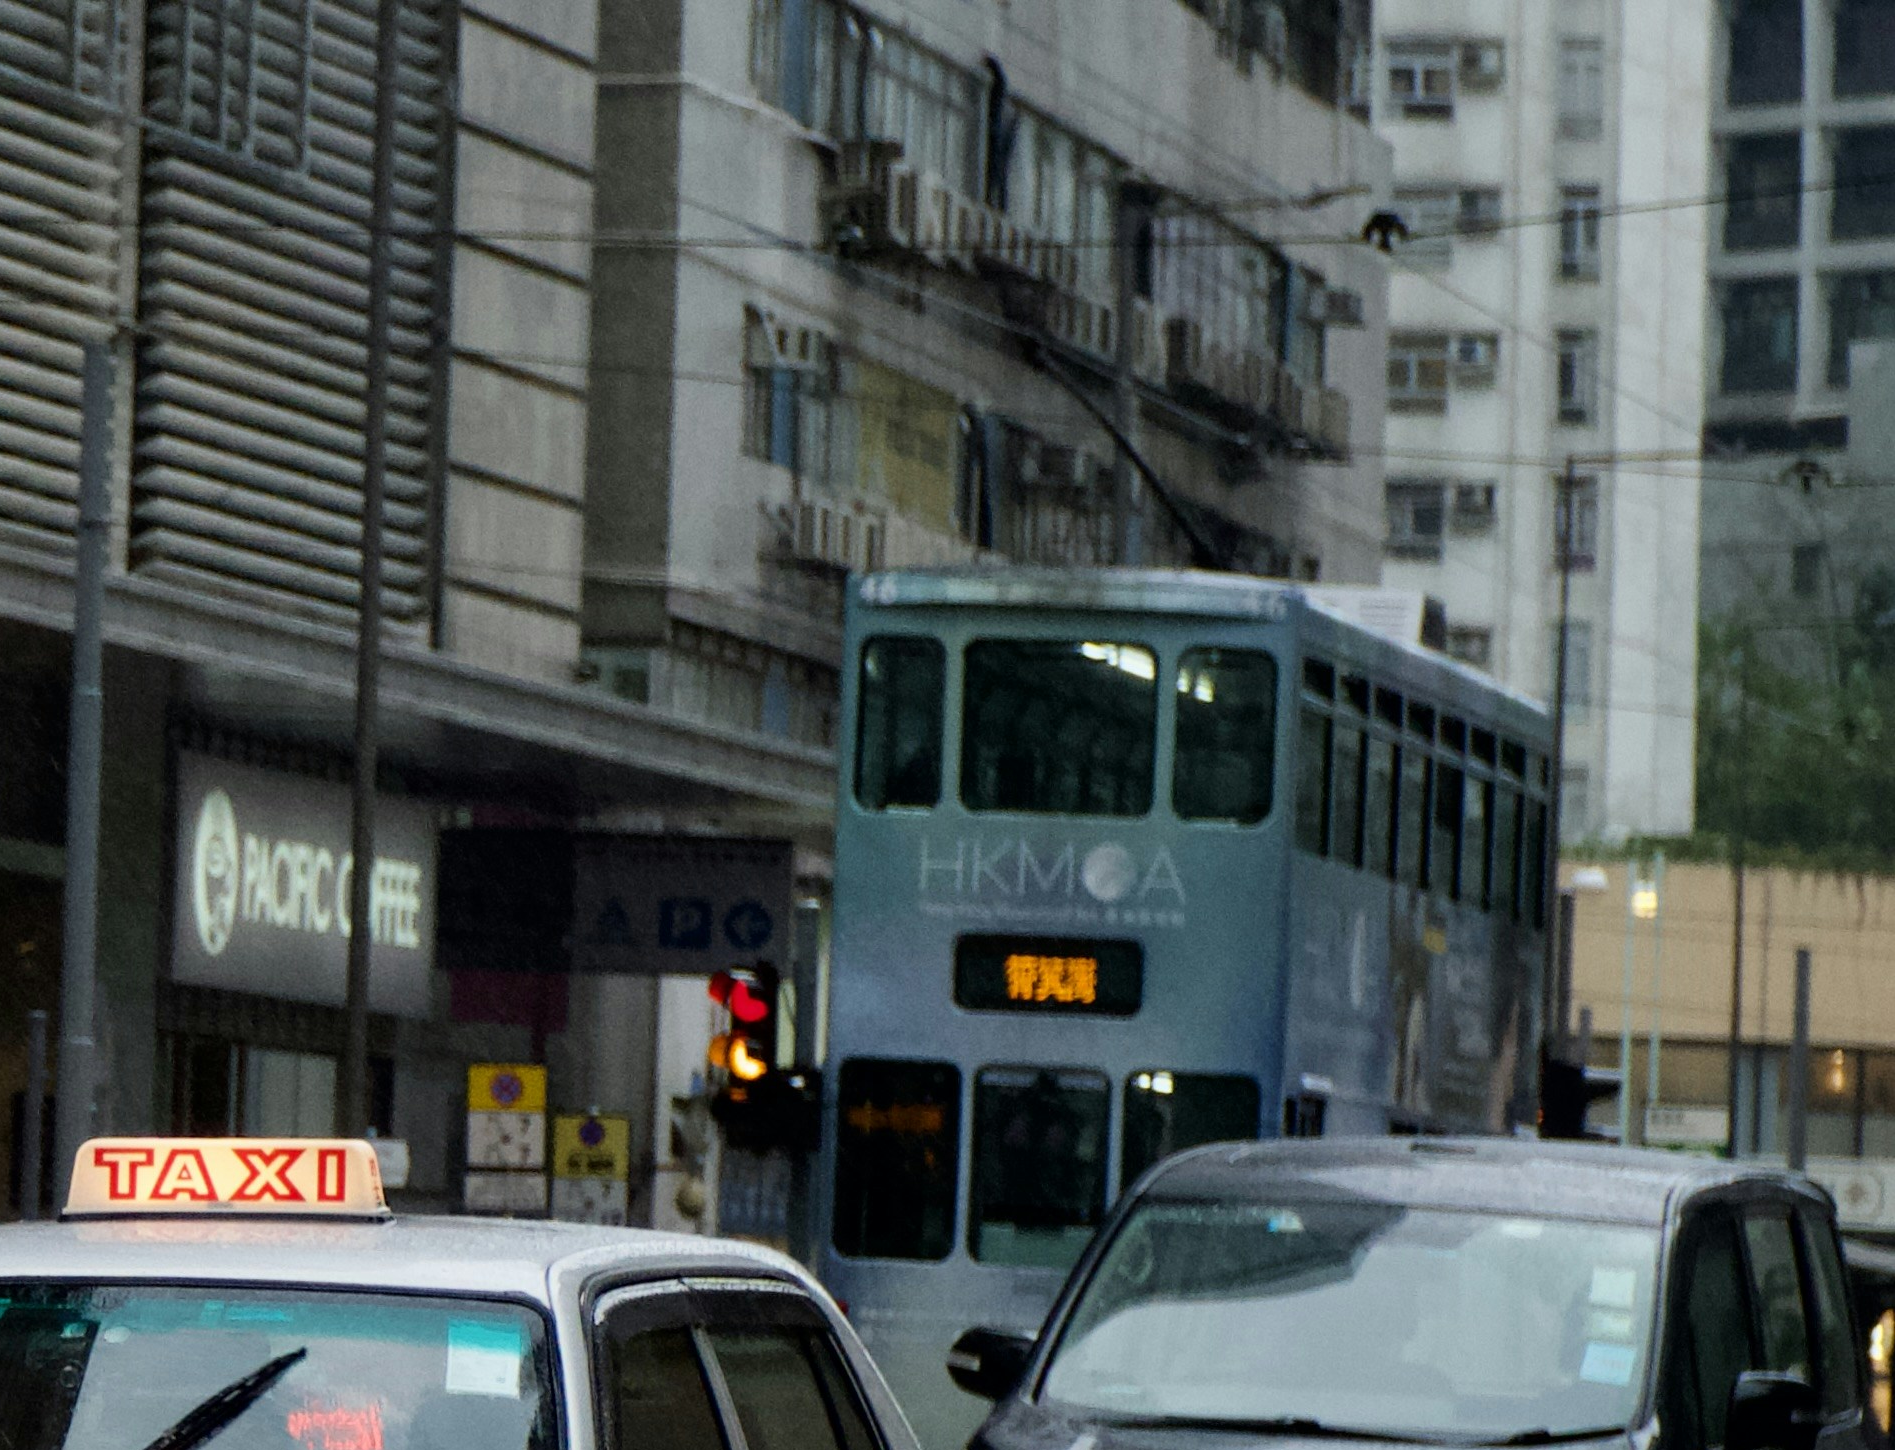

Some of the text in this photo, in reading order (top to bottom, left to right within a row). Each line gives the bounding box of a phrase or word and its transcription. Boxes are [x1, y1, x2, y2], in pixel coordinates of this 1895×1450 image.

[242, 832, 422, 948] PACIFIC CFFEE
[93, 1147, 347, 1203] TAXI
